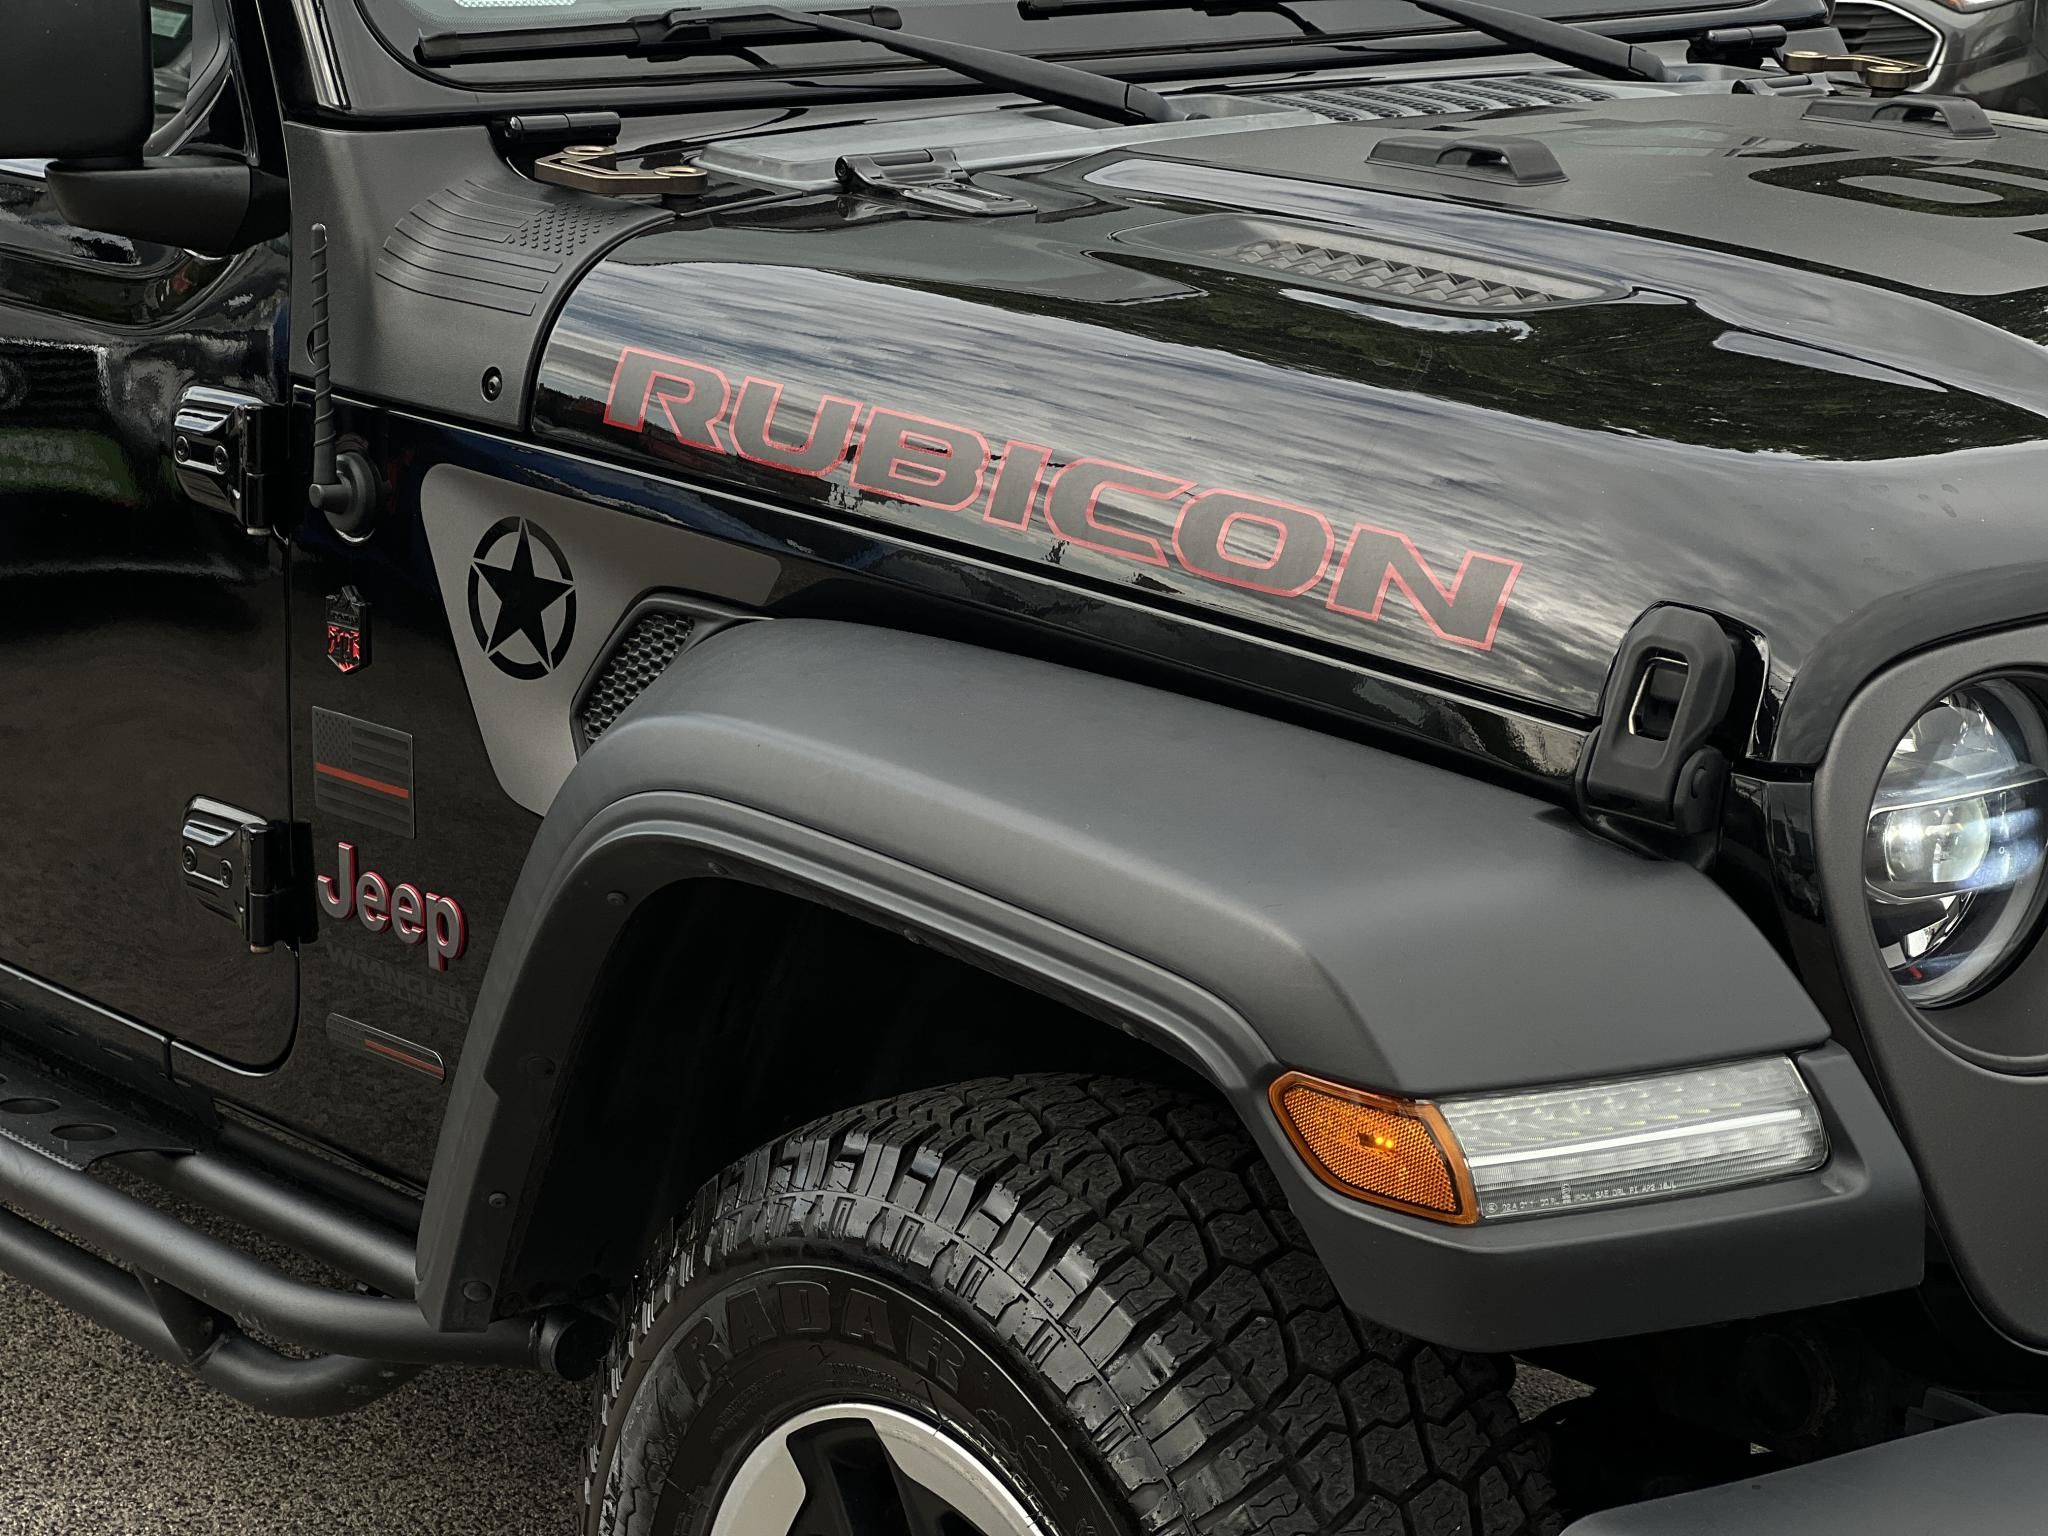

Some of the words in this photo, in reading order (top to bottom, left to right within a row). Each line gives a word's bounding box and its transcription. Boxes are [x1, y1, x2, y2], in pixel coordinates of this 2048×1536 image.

[602, 346, 1522, 650] RUBICON
[317, 840, 468, 973] Jeep
[326, 940, 468, 1014] WRANGLER
[672, 1280, 966, 1397] RADAR
